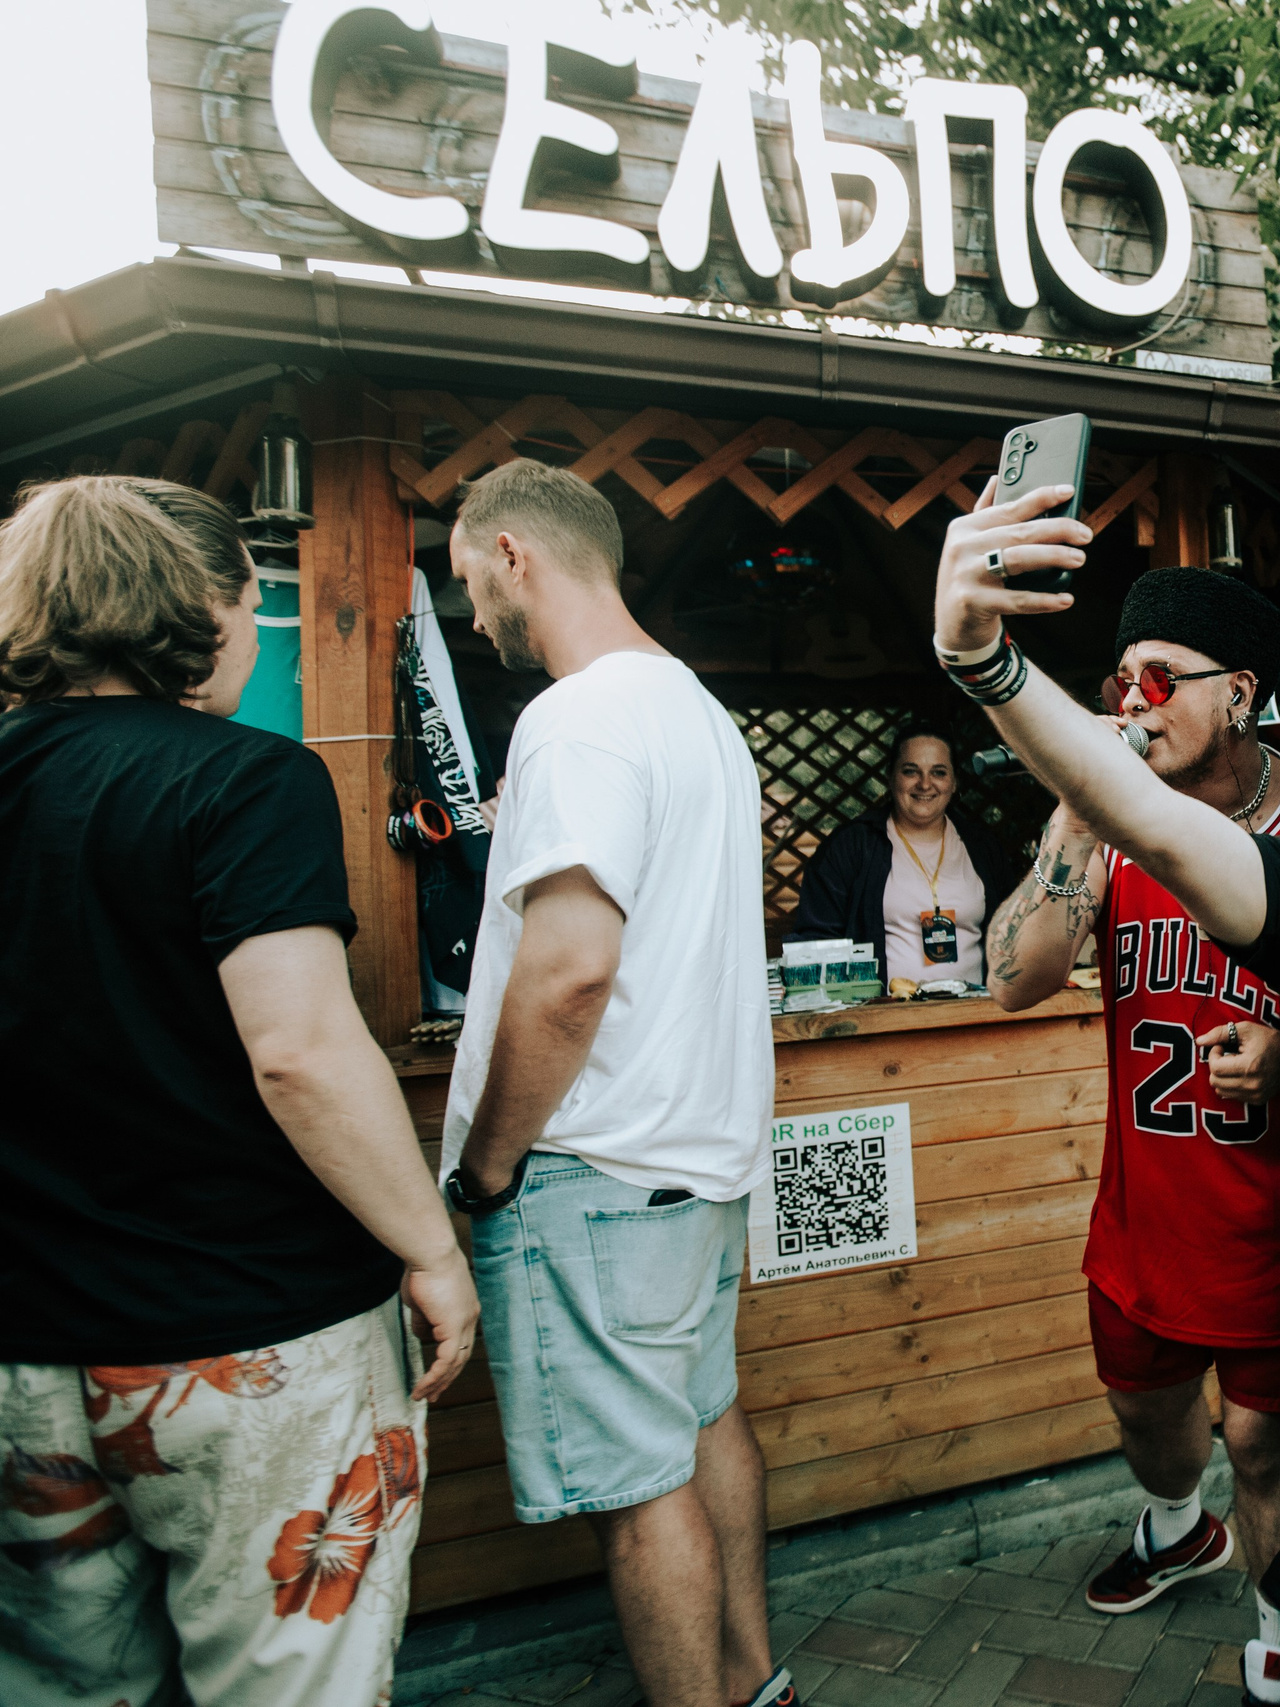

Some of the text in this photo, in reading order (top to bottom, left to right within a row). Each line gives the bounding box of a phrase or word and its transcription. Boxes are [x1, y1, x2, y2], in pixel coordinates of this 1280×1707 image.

[271, 0, 1193, 317] СЕЛЬПО
[803, 1123, 829, 1138] на
[838, 1114, 895, 1133] Сбер
[756, 1244, 913, 1280] Артём Анатольевич С.
